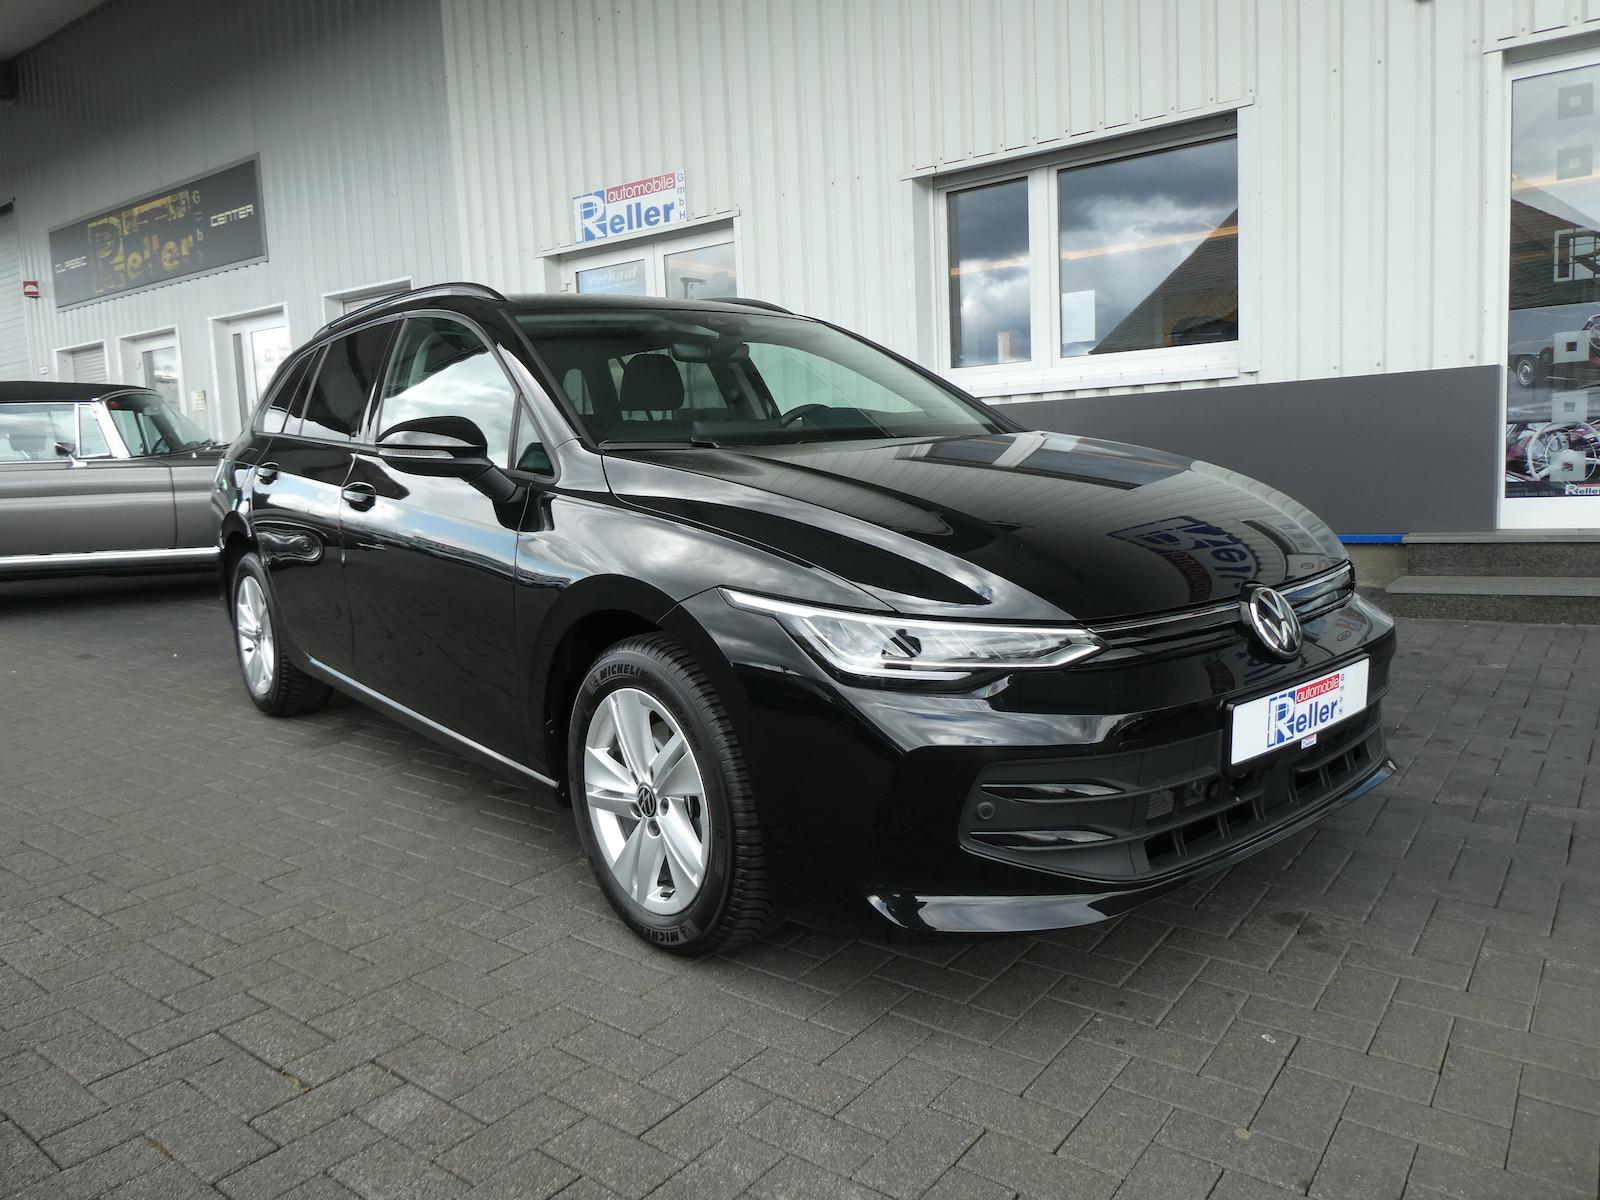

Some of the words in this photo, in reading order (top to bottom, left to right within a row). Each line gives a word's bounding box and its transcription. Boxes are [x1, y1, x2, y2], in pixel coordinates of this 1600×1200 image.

[607, 175, 675, 203] automobile
[210, 204, 254, 227] CENTER
[572, 189, 675, 244] Reller
[1296, 675, 1339, 703] automobile
[1267, 690, 1338, 748] Reller
